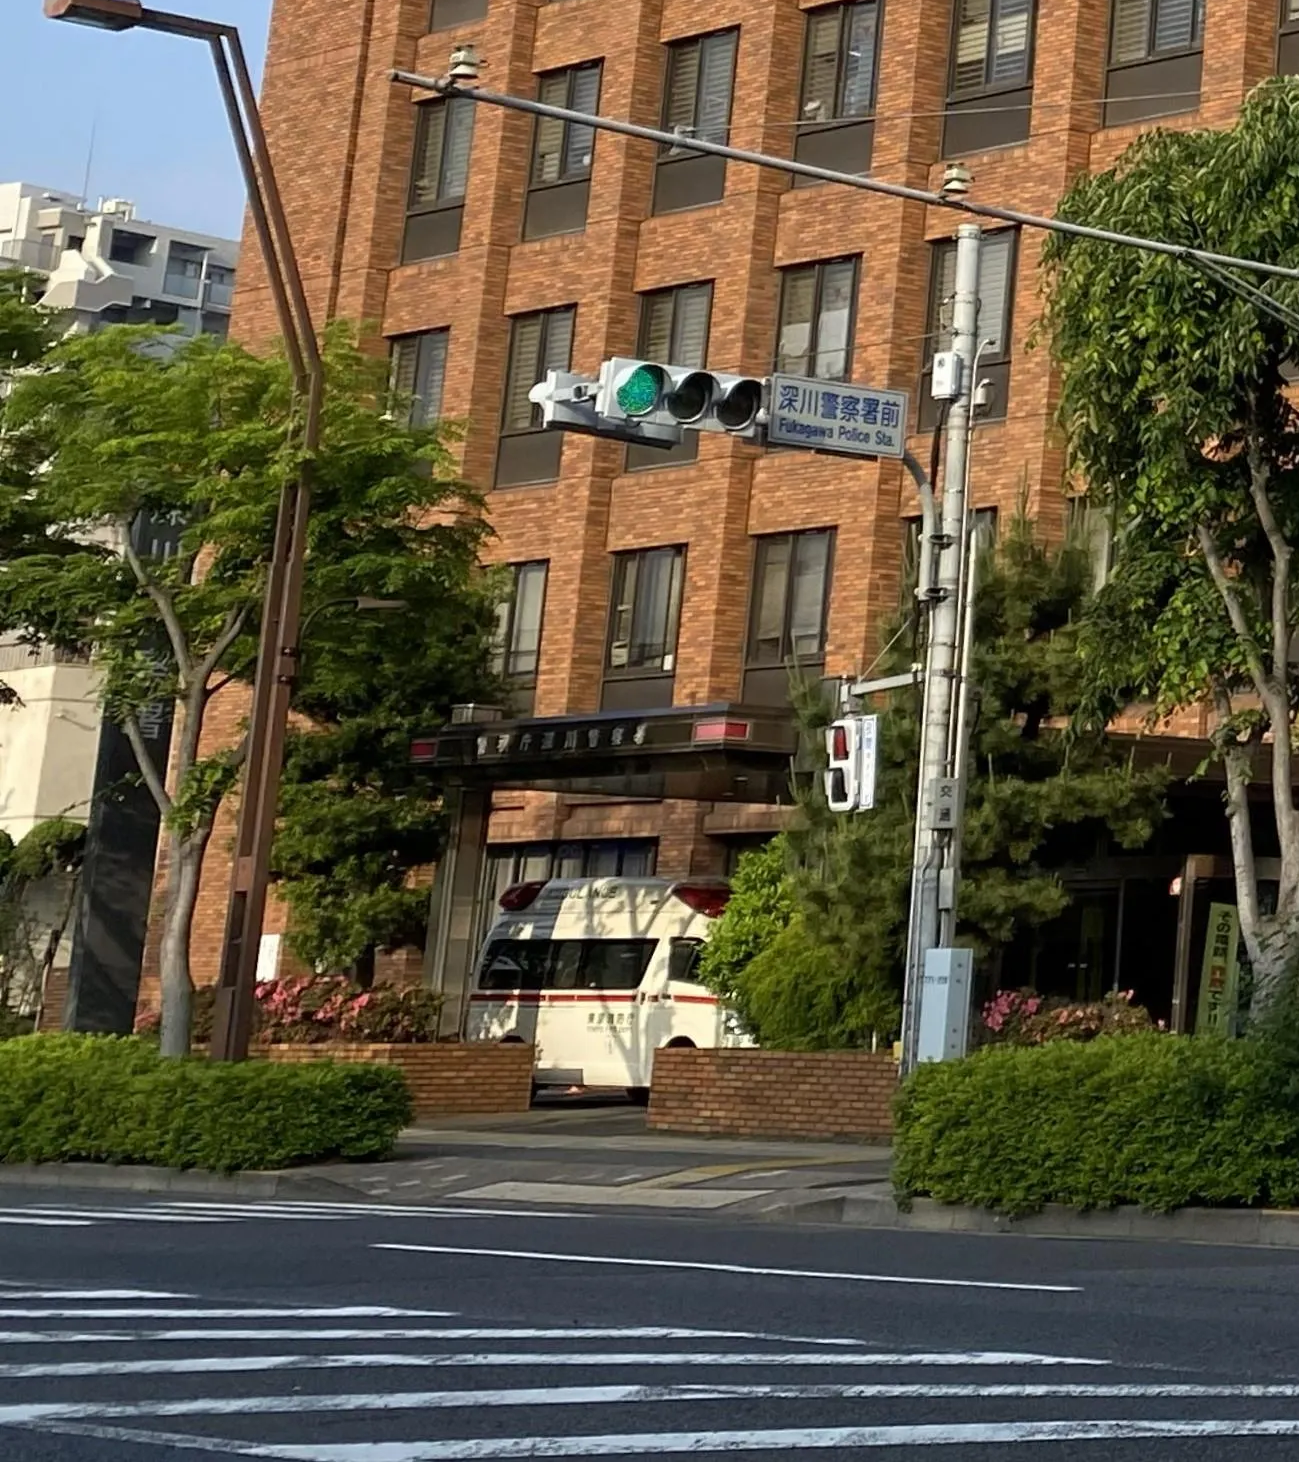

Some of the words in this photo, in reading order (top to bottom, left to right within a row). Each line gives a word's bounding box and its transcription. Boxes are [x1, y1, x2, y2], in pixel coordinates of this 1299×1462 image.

[778, 384, 901, 429] 深川警察署前
[778, 417, 834, 439] Fukagawa
[838, 425, 871, 444] Police
[875, 430, 895, 447] Sta.
